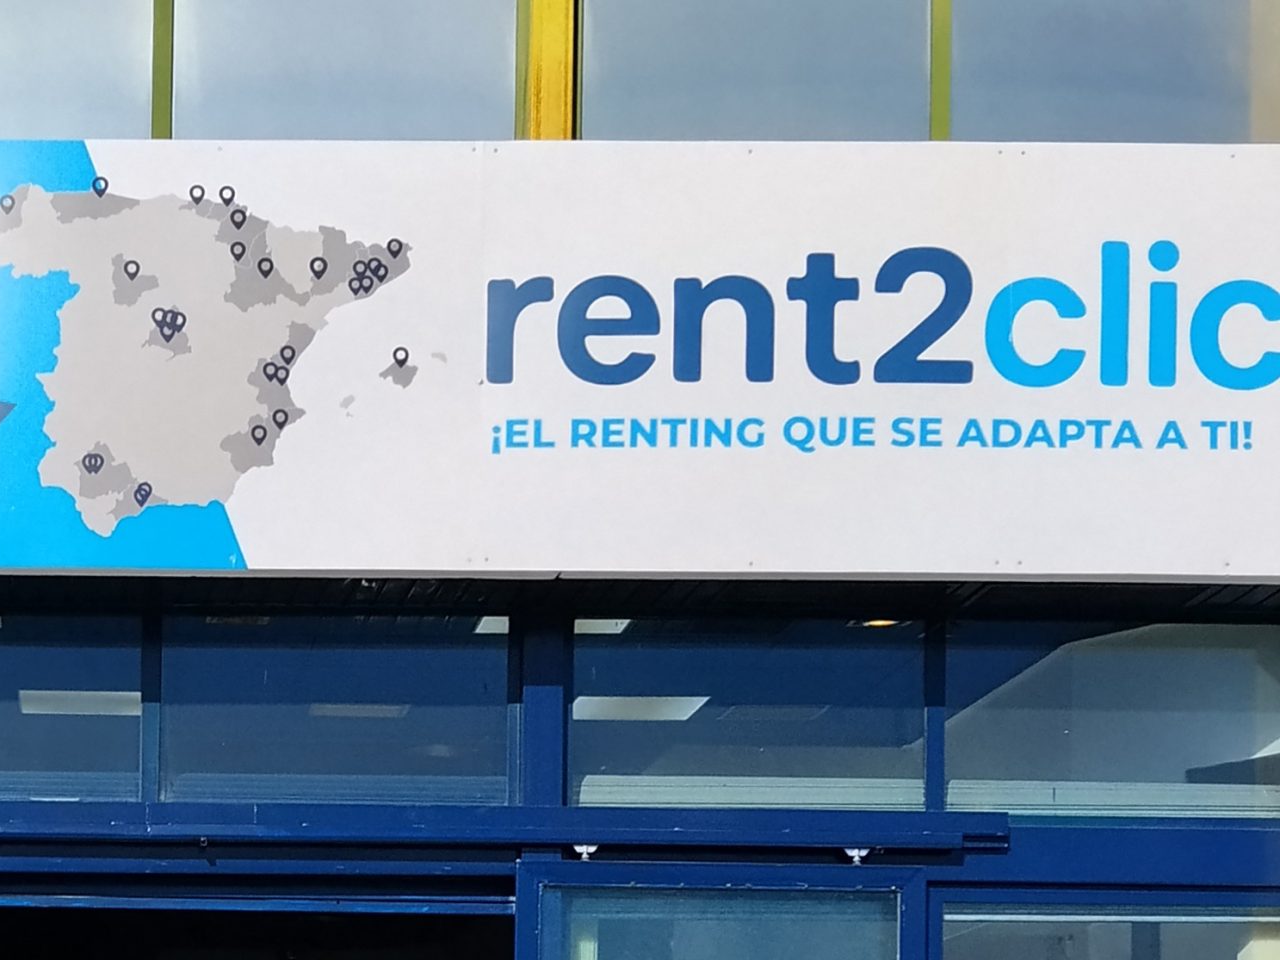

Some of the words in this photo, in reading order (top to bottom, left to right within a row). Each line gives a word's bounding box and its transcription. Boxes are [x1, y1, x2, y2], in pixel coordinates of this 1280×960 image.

[486, 240, 1280, 390] rent2clic
[491, 417, 555, 454] ¡EL
[571, 417, 765, 449] RENTING
[783, 416, 875, 453] QUE
[890, 417, 943, 449] SE
[956, 418, 1143, 450] ADAPTA
[1155, 420, 1188, 451] A
[1201, 420, 1254, 451] TI!
